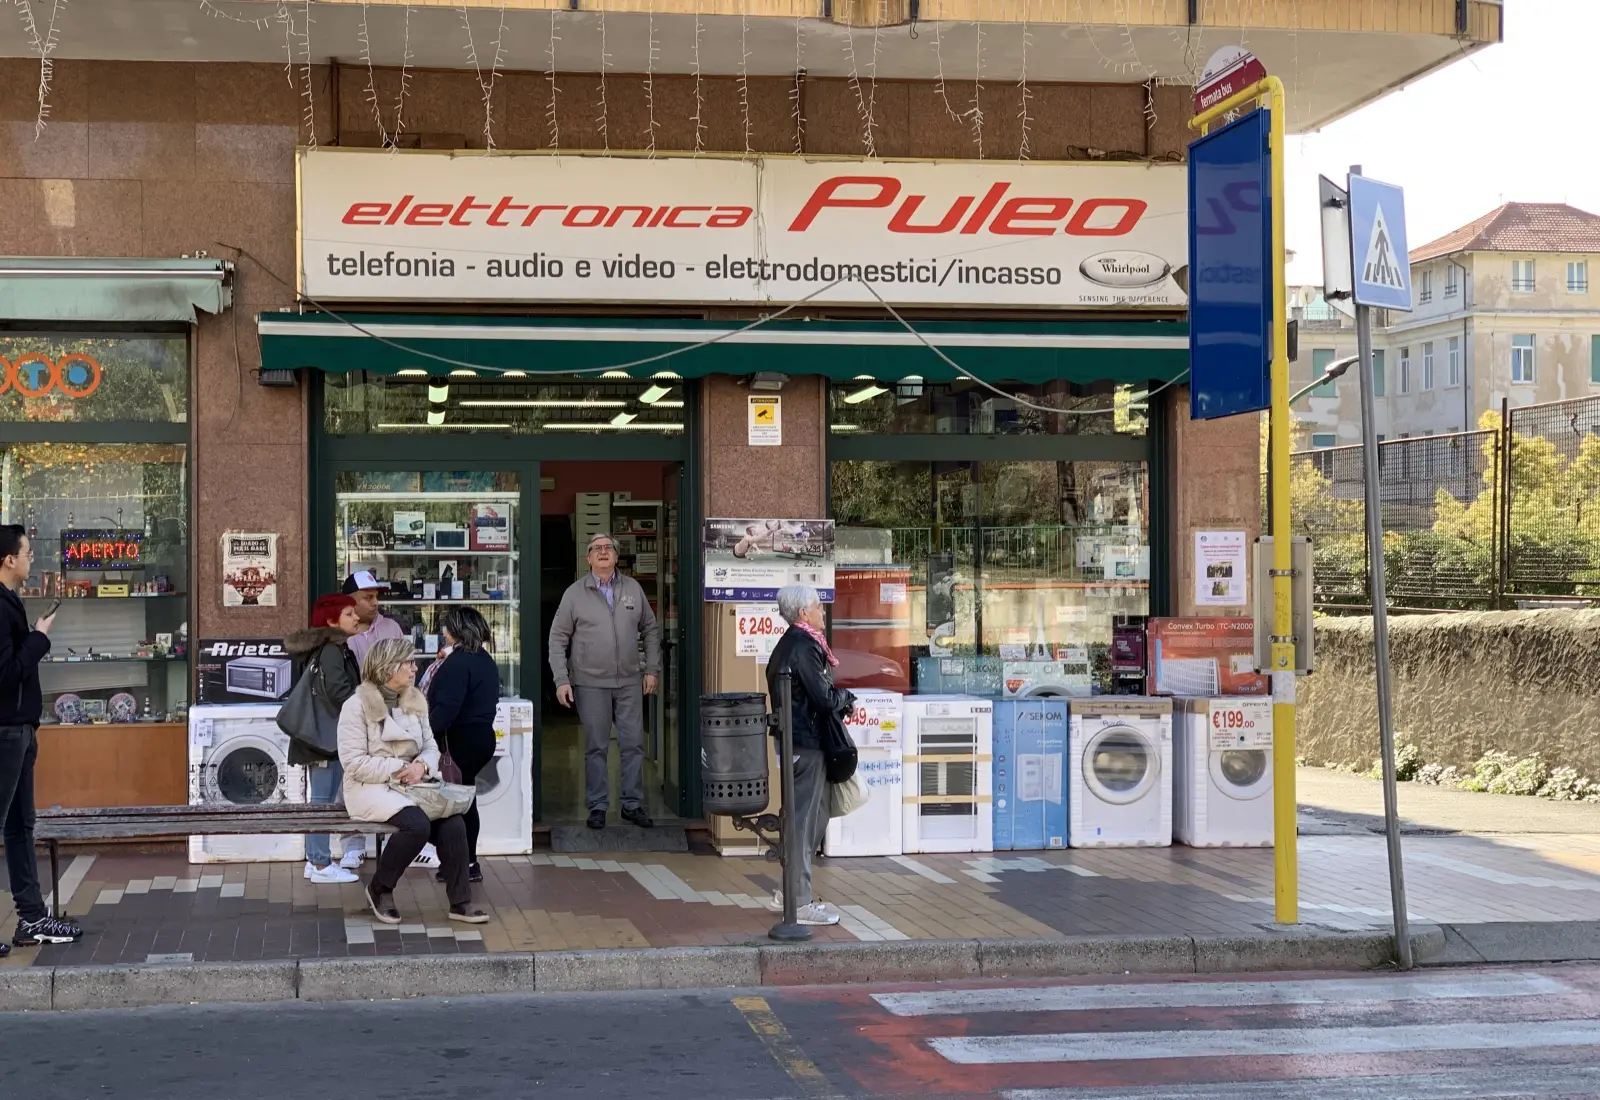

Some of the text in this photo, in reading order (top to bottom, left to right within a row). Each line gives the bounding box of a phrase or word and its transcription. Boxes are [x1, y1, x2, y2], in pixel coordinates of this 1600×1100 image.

[1200, 82, 1232, 108] fermata bus
[341, 194, 754, 228] elettronica
[787, 175, 1148, 236] Puleo
[327, 250, 455, 277] telefonia
[486, 252, 564, 279] audio
[575, 260, 592, 278] e
[602, 253, 676, 280] video
[704, 254, 1062, 287] elettrodomestici/incasso
[1101, 263, 1150, 276] Whirlpool
[1078, 295, 1109, 303] SENSING
[1112, 295, 1126, 303] THE
[67, 542, 139, 559] APERTO
[739, 616, 785, 636] € 249,00
[1168, 622, 1193, 630] Convex
[1196, 622, 1215, 630] Turbo
[205, 641, 288, 657] Ariete
[1029, 711, 1062, 721] SEKOM
